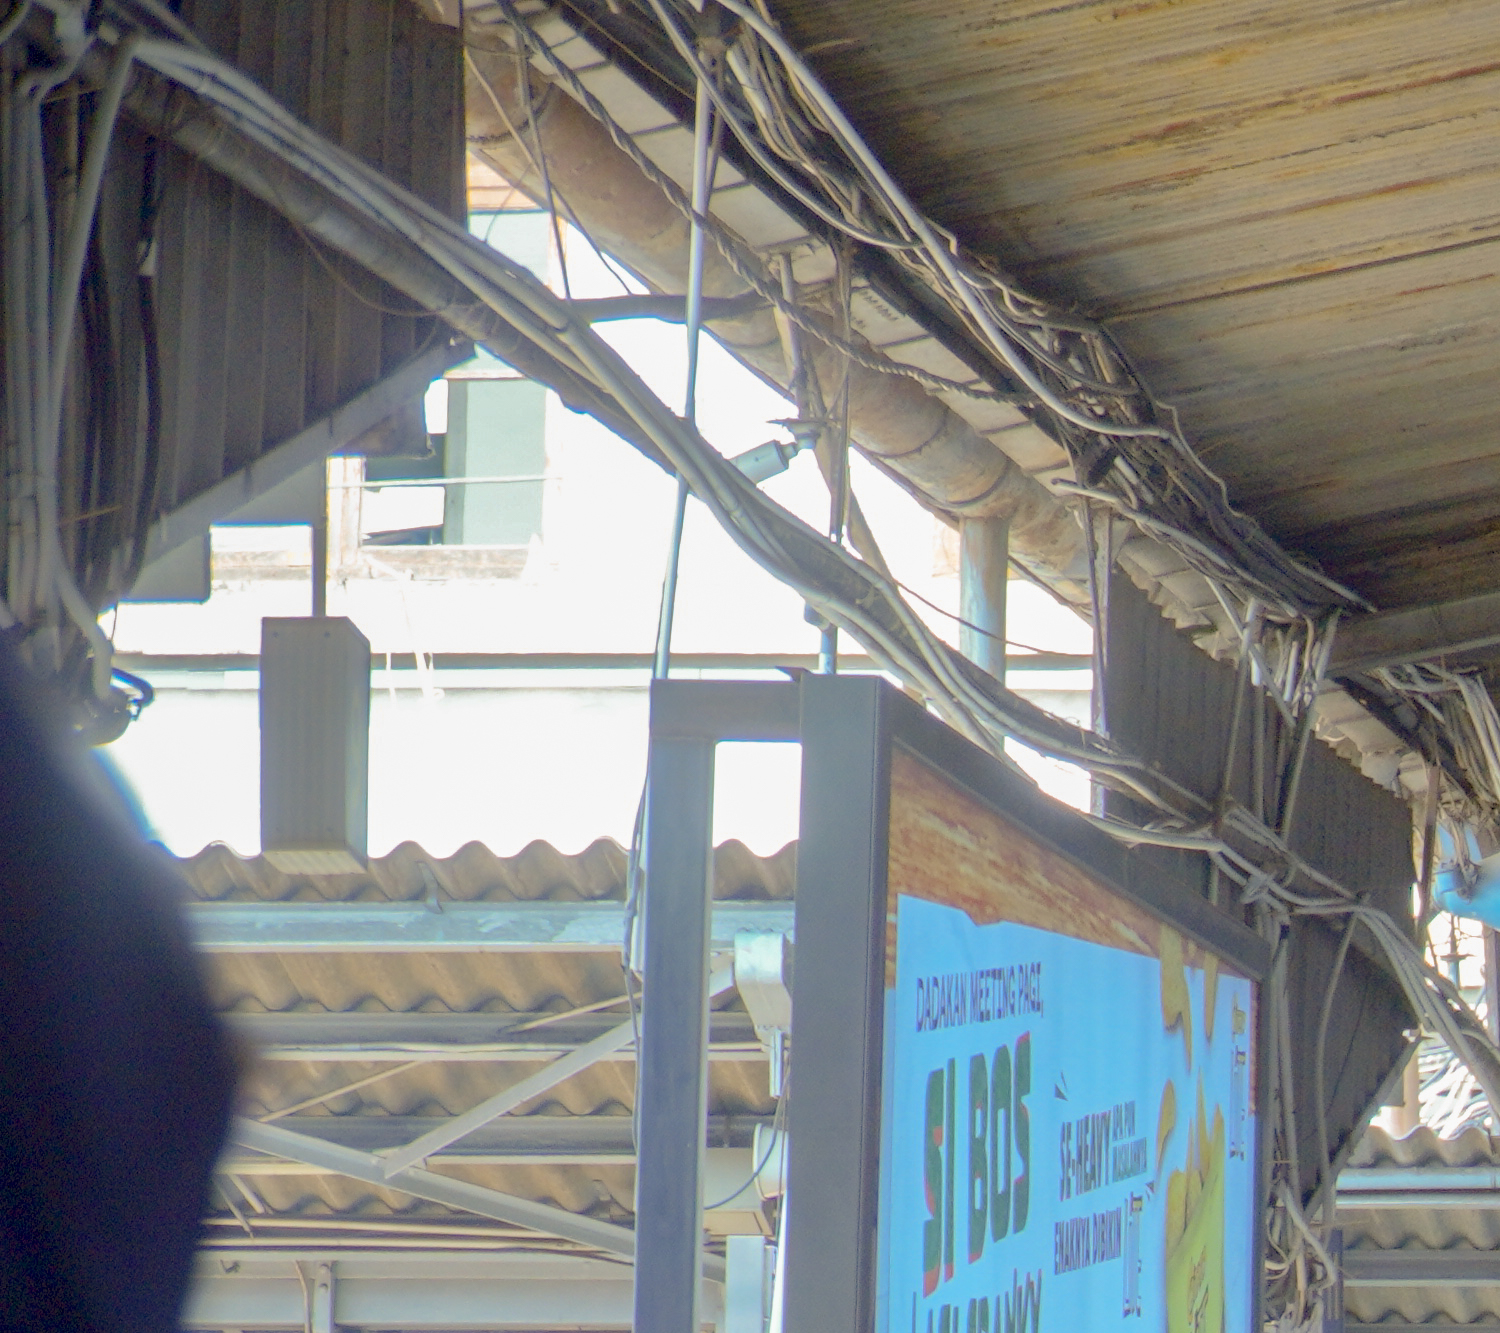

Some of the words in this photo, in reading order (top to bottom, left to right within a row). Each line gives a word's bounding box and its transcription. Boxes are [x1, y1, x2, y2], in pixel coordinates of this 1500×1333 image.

[916, 972, 967, 1033] DADAKAN
[969, 964, 1016, 1024] MEETING
[923, 1057, 956, 1299] SI
[968, 1030, 1031, 1265] BOS
